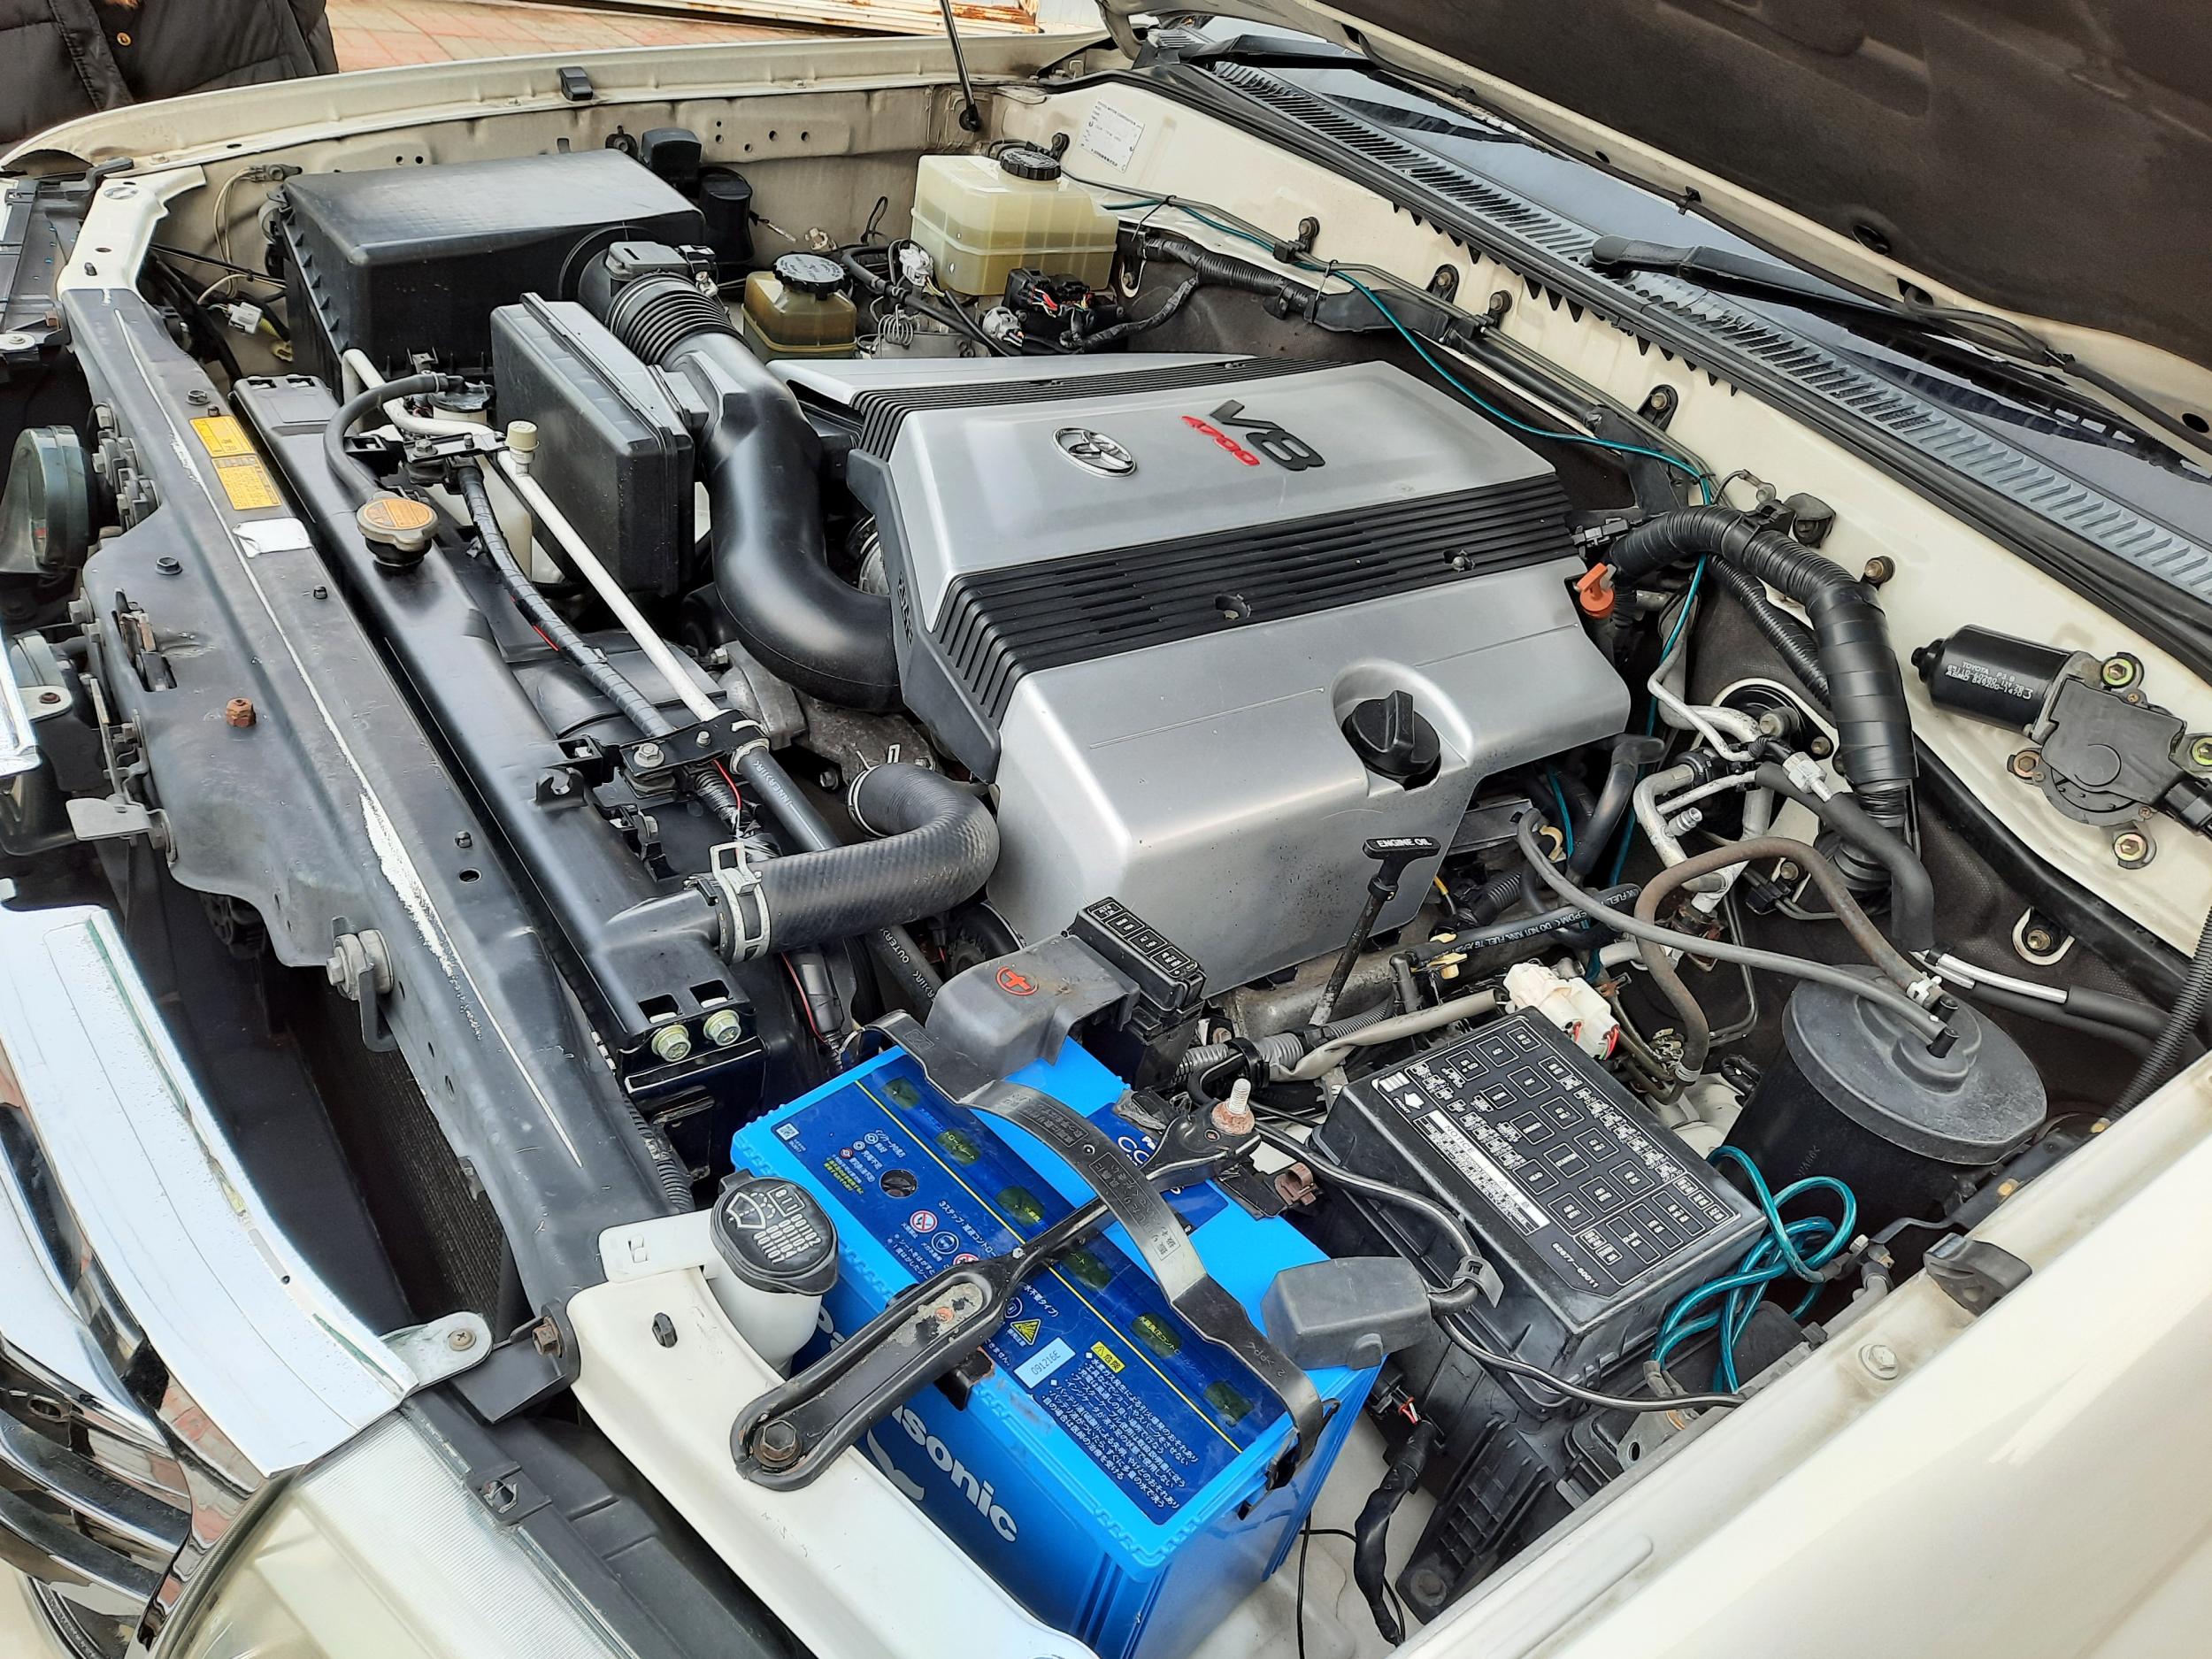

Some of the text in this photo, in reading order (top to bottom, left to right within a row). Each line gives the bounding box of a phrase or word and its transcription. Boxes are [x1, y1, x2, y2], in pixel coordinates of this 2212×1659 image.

[1181, 415, 1261, 466] 4700
[1209, 399, 1325, 472] V8
[1962, 661, 1989, 675] TOYOTA
[1376, 838, 1415, 848] ENGINE
[1538, 920, 1552, 932] DO
[1485, 932, 1506, 948] FUEL
[1392, 1096, 1411, 1116] FRONT
[1442, 1124, 1476, 1155] NOTICE
[1031, 1350, 1062, 1376] 091216E
[1101, 1352, 1124, 1371] 危険
